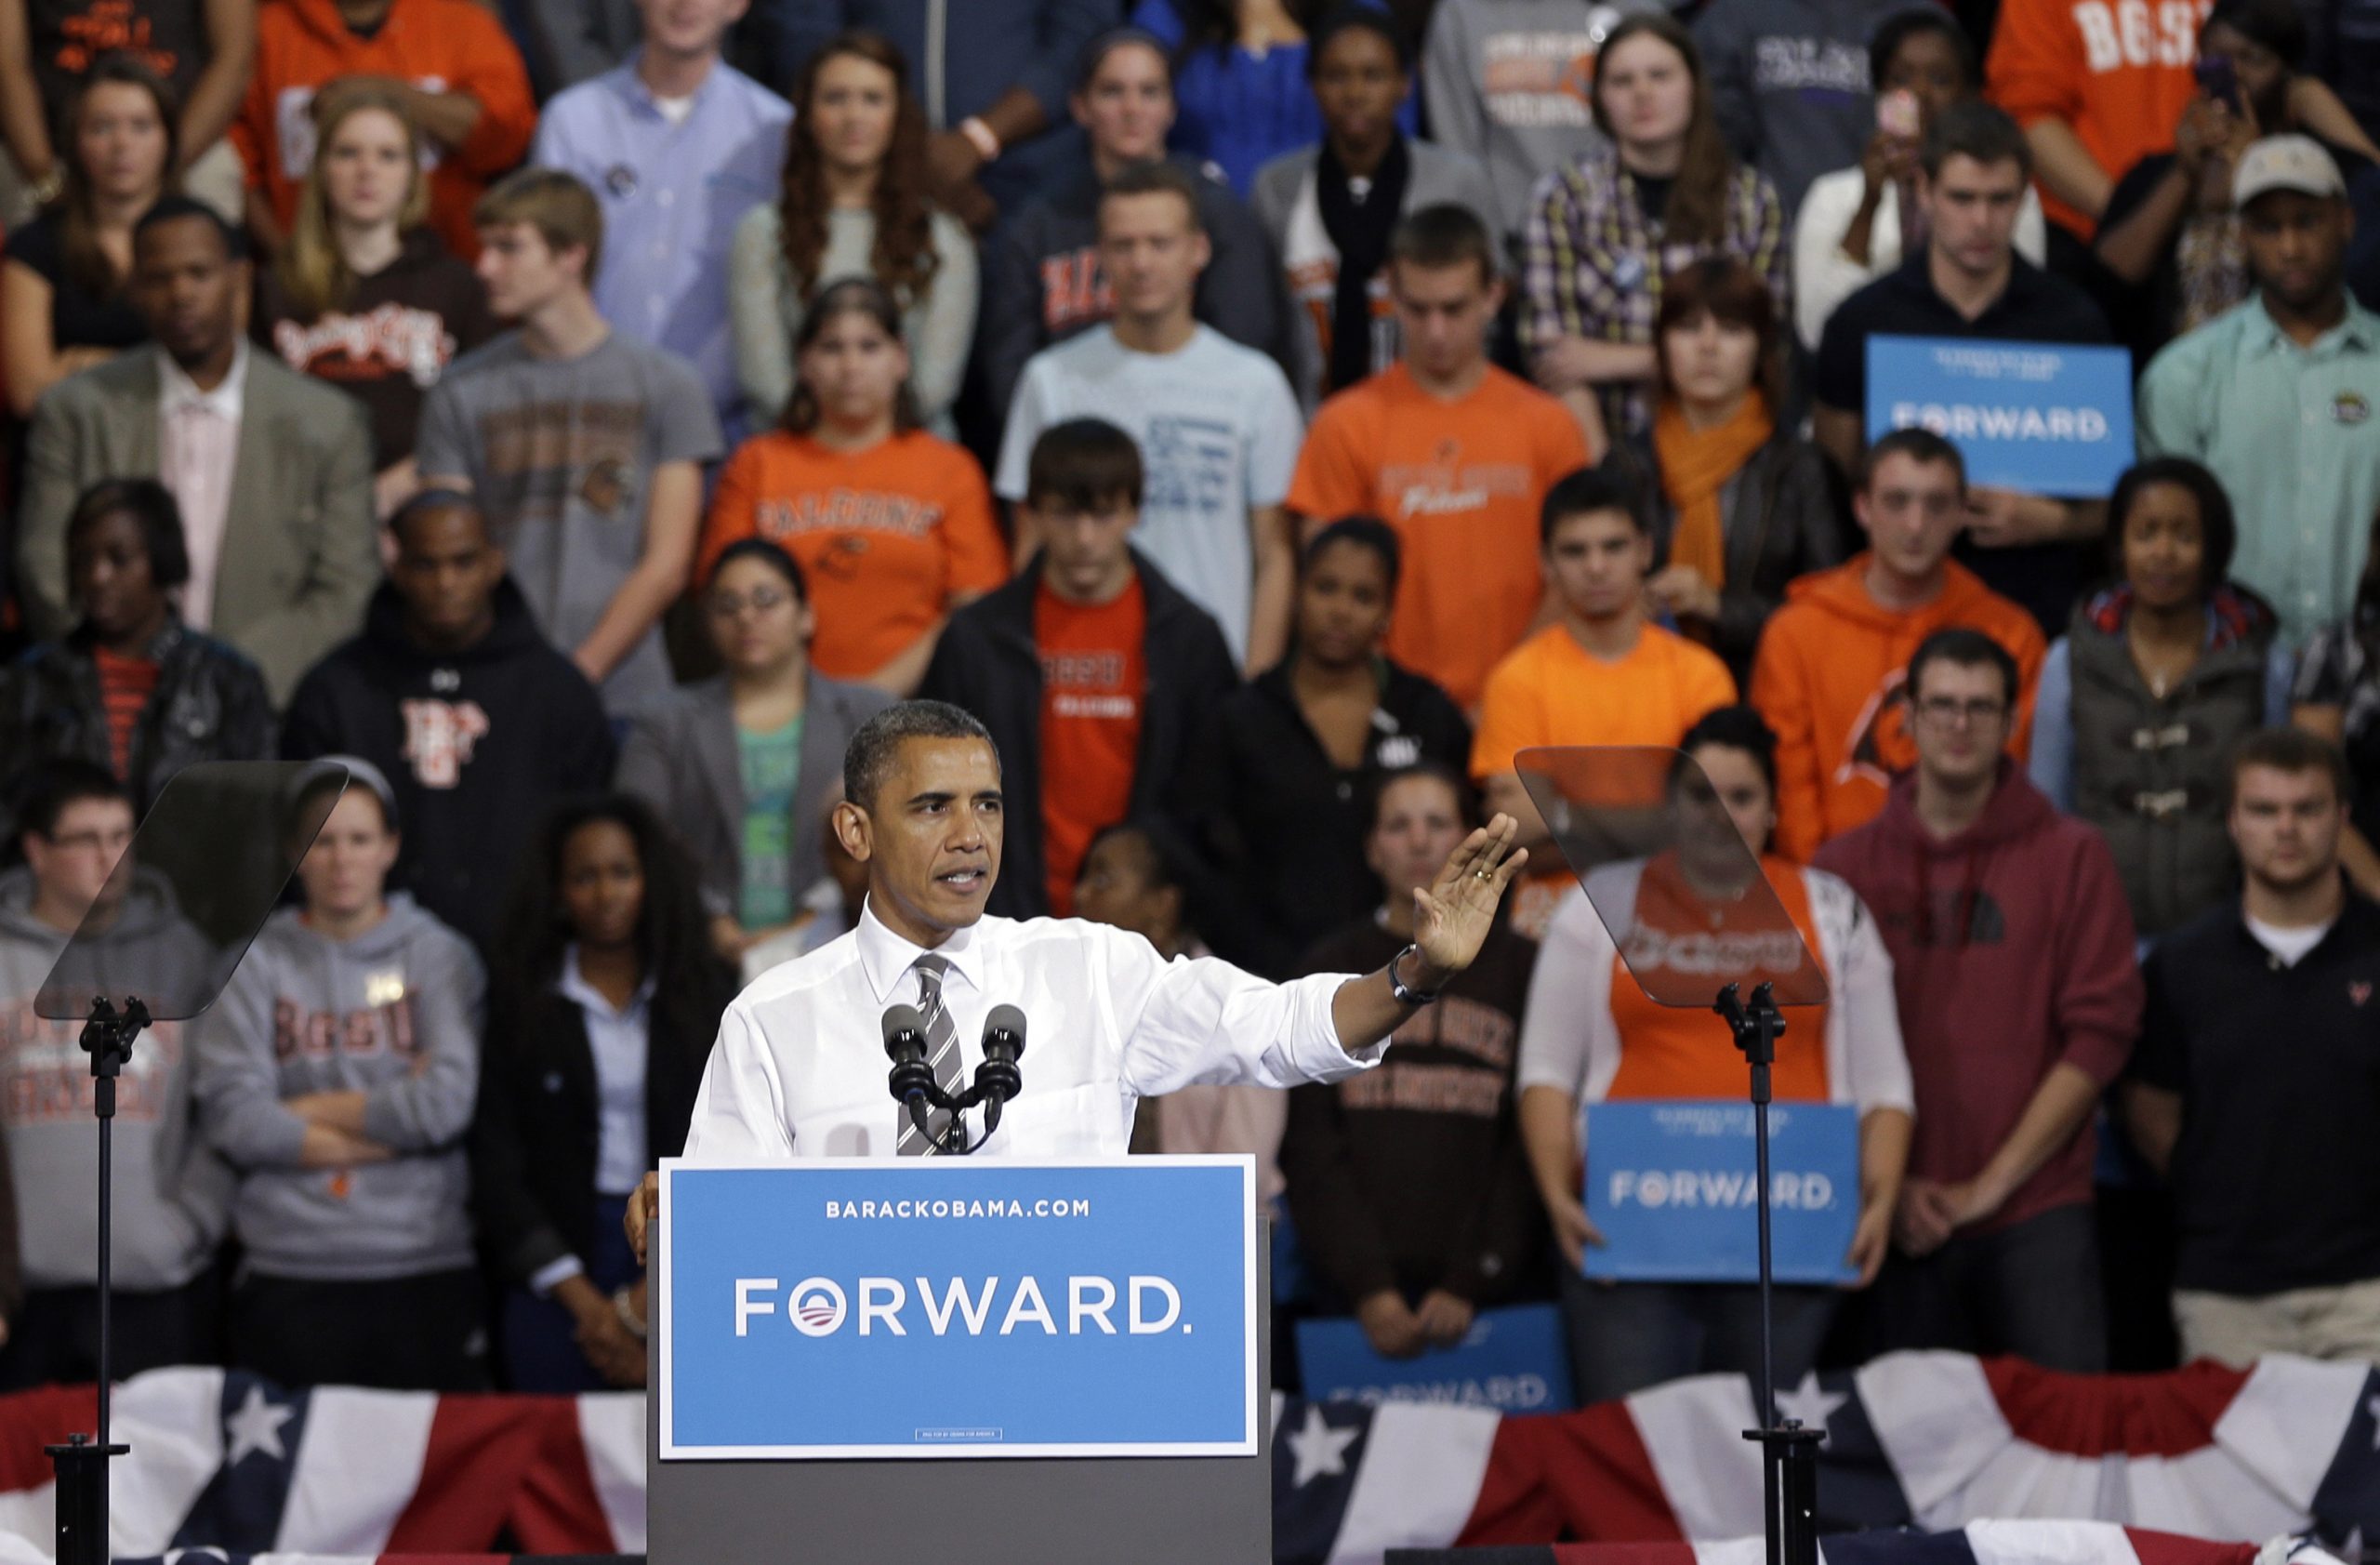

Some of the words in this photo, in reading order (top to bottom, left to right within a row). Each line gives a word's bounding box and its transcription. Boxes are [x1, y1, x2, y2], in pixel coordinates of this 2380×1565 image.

[2074, 0, 2212, 72] BGS
[826, 1200, 1091, 1218] BARACKOBAMA.COM
[734, 1275, 1192, 1337] FORWARD.
